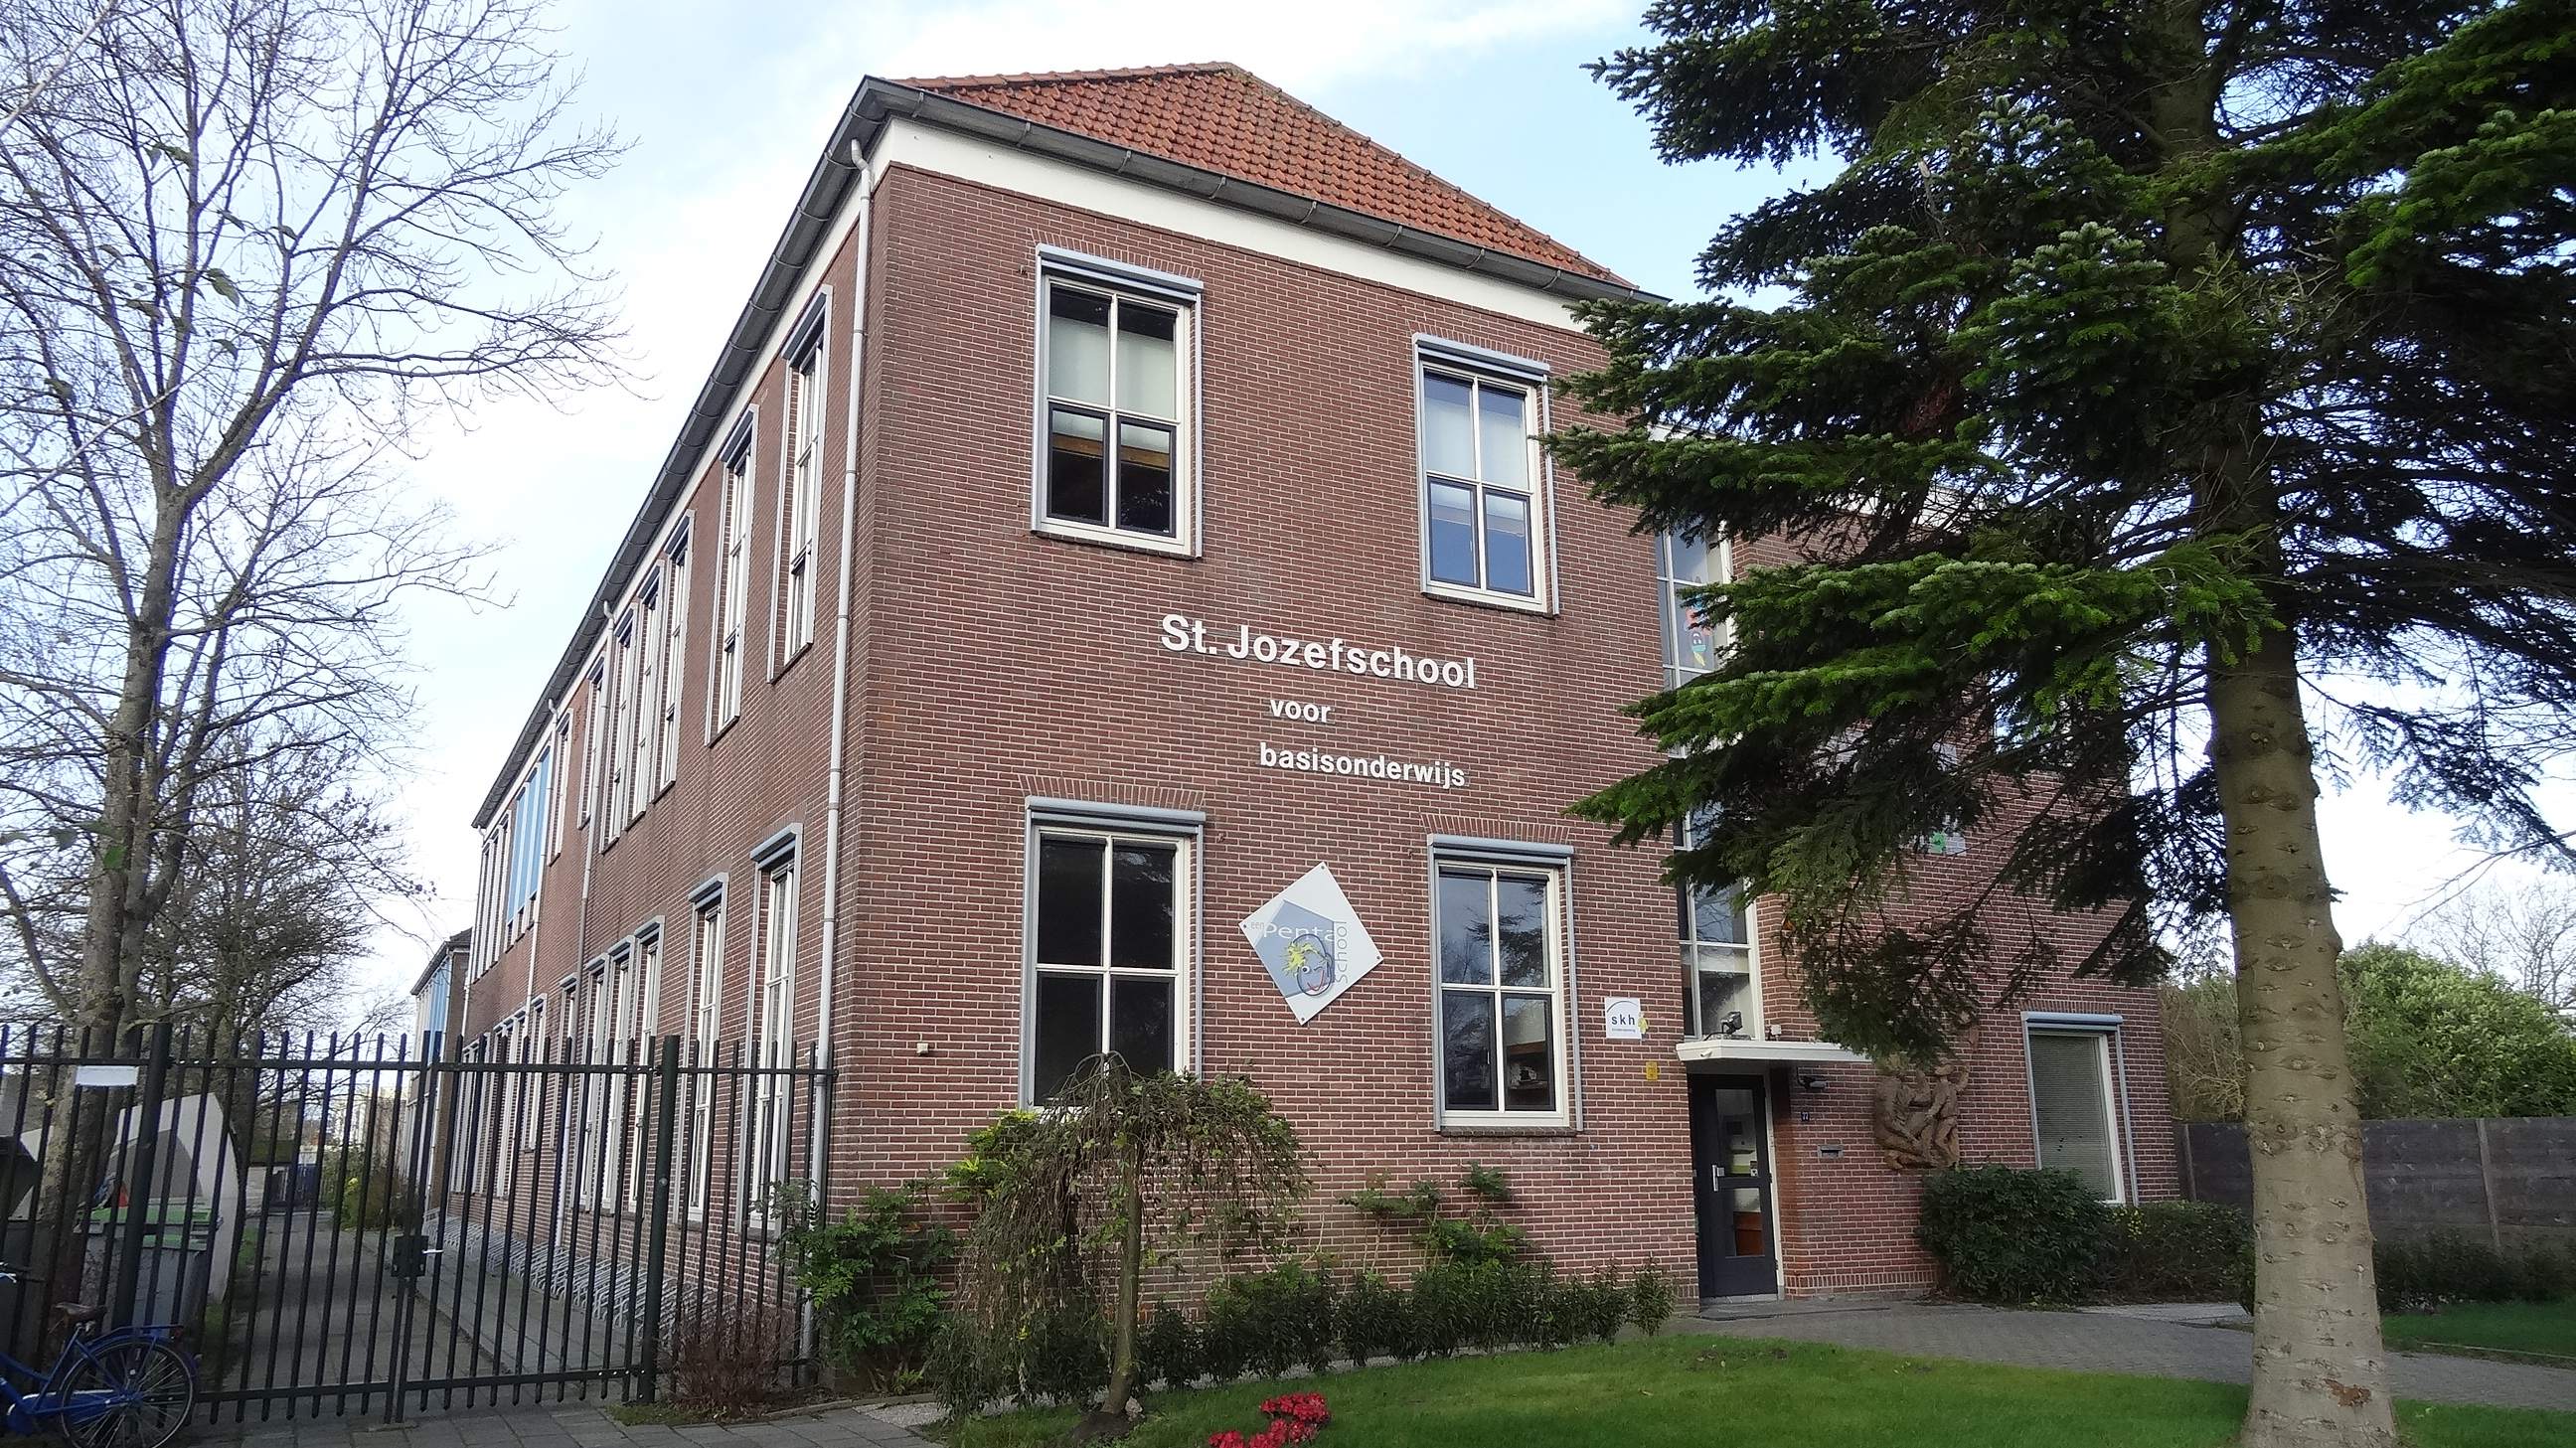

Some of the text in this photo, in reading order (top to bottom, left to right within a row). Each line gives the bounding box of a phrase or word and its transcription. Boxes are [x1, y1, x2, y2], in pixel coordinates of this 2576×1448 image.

[1161, 613, 1476, 689] St. Jozefschool
[1269, 699, 1332, 724] voor
[1259, 741, 1466, 790] basisonderwijs
[1263, 922, 1334, 942] Penta
[1335, 921, 1349, 984] School
[1611, 1014, 1636, 1026] skh
